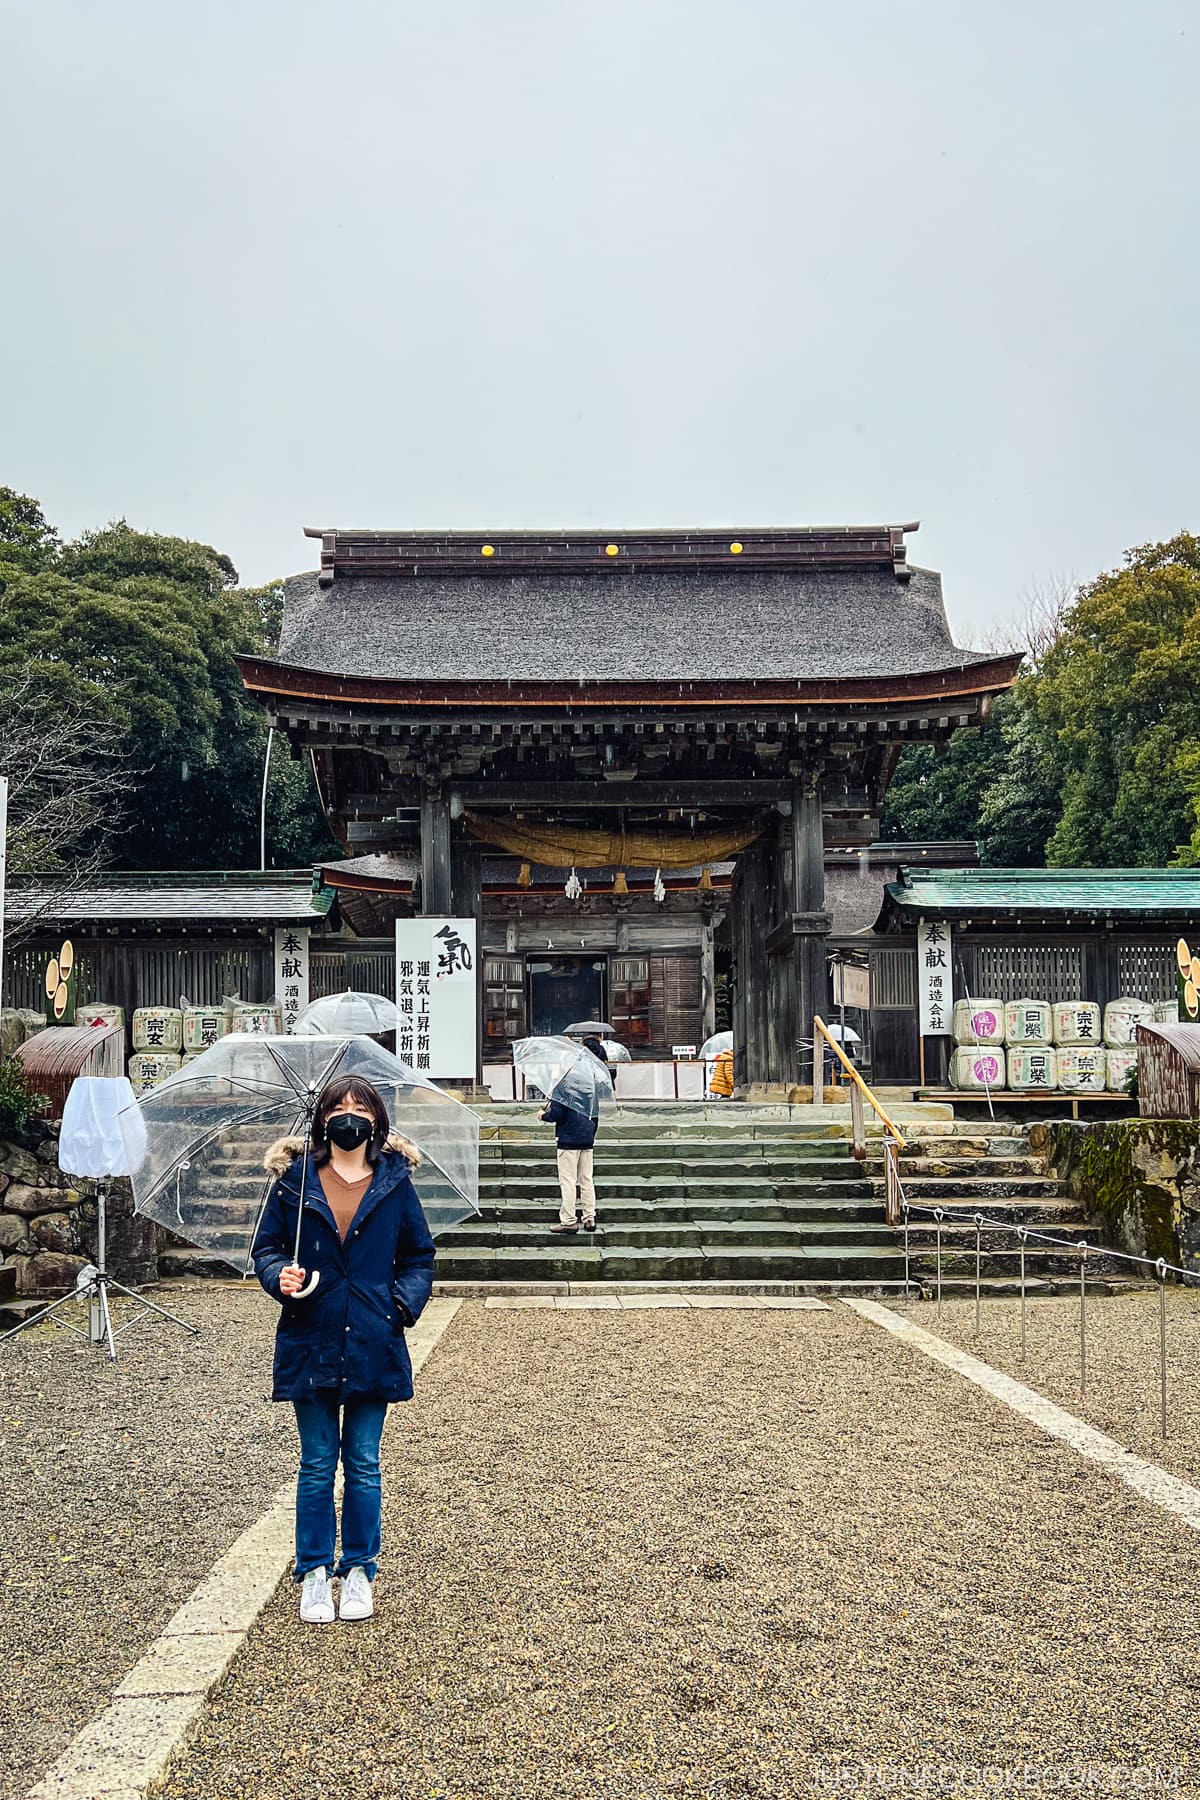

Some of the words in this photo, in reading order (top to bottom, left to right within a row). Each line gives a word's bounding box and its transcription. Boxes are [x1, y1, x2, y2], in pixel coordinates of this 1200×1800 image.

[280, 933, 303, 978] 奉献
[924, 923, 948, 968] 奉献
[416, 960, 431, 1070] 運気上昇祈願
[928, 975, 945, 1030] 酒造会社
[1077, 1011, 1093, 1038] 宗玄
[147, 1018, 164, 1046] 宗玄
